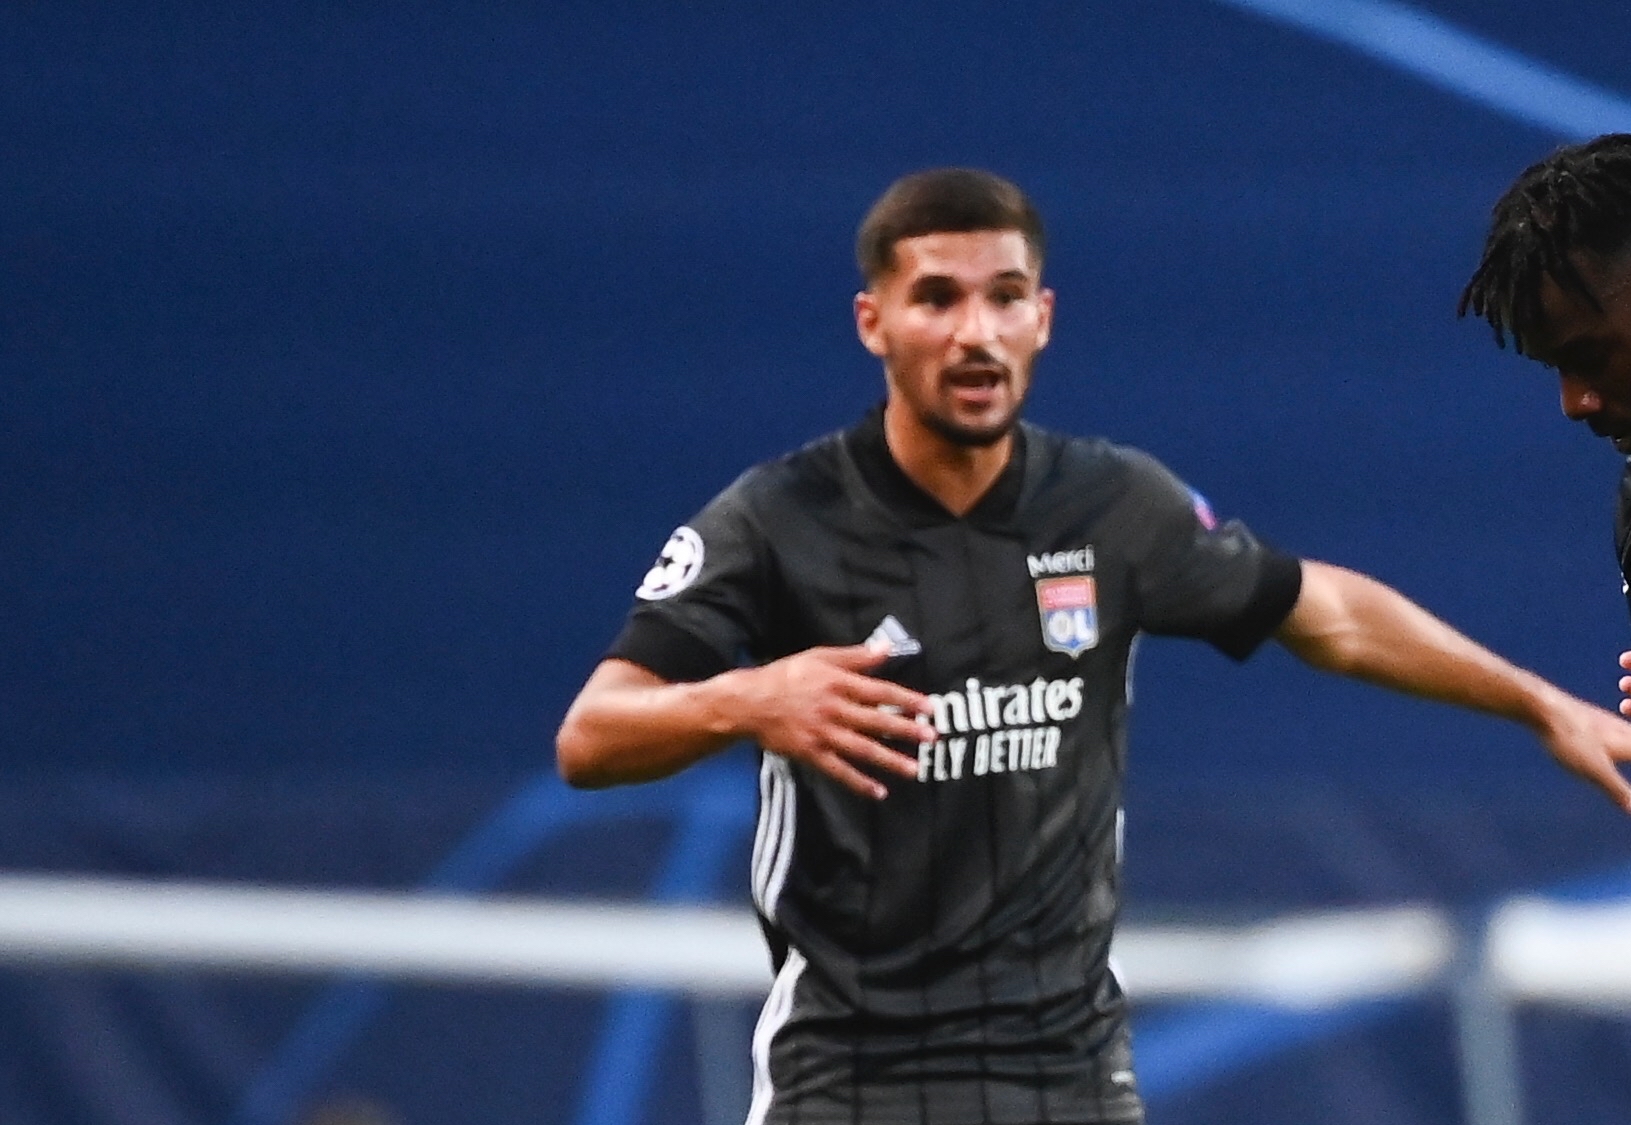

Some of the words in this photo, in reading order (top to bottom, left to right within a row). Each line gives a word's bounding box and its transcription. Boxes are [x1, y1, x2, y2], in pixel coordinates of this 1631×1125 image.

[1027, 544, 1095, 578] Merci
[877, 676, 1085, 737] mirates
[917, 737, 967, 783] FLY
[973, 725, 1062, 777] BETTER
